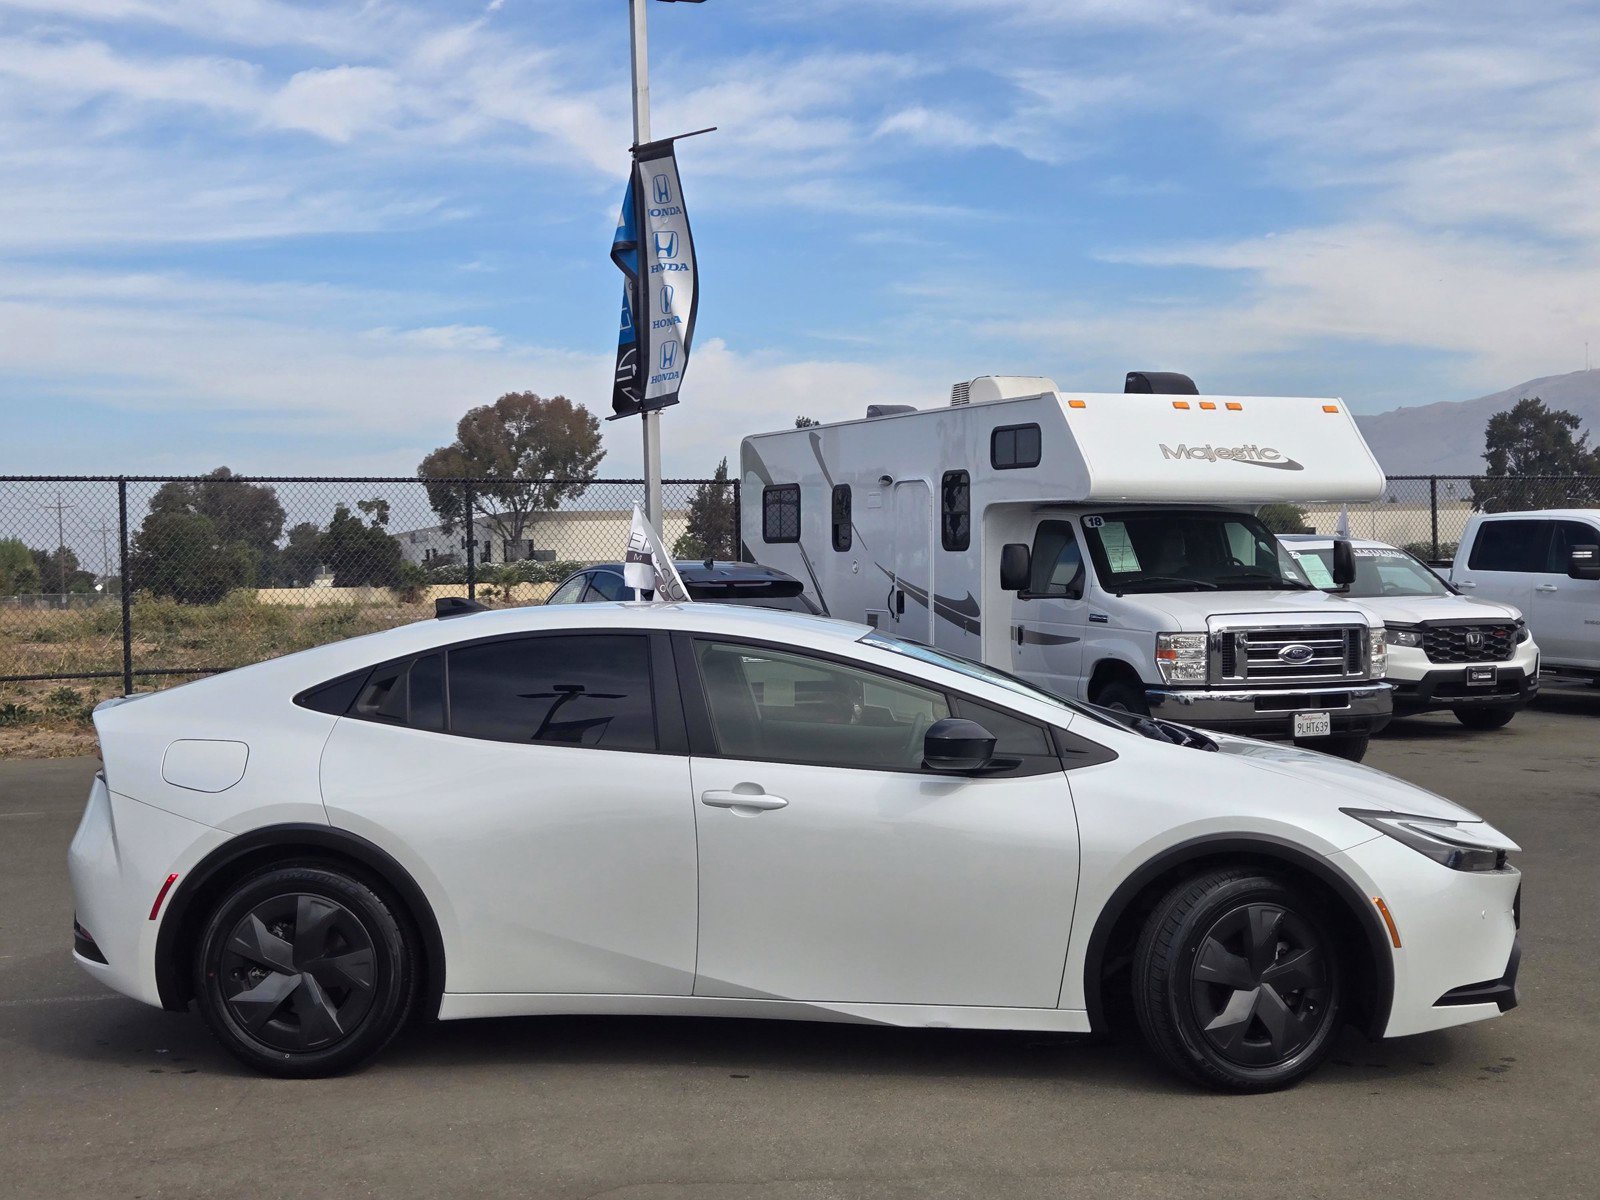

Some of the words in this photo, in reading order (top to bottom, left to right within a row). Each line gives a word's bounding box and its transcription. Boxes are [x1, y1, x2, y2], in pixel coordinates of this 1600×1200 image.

[650, 371, 680, 384] HONDA
[1158, 443, 1281, 462] Majestic
[1088, 516, 1103, 527] 18
[1297, 721, 1328, 734] 9LHT639
